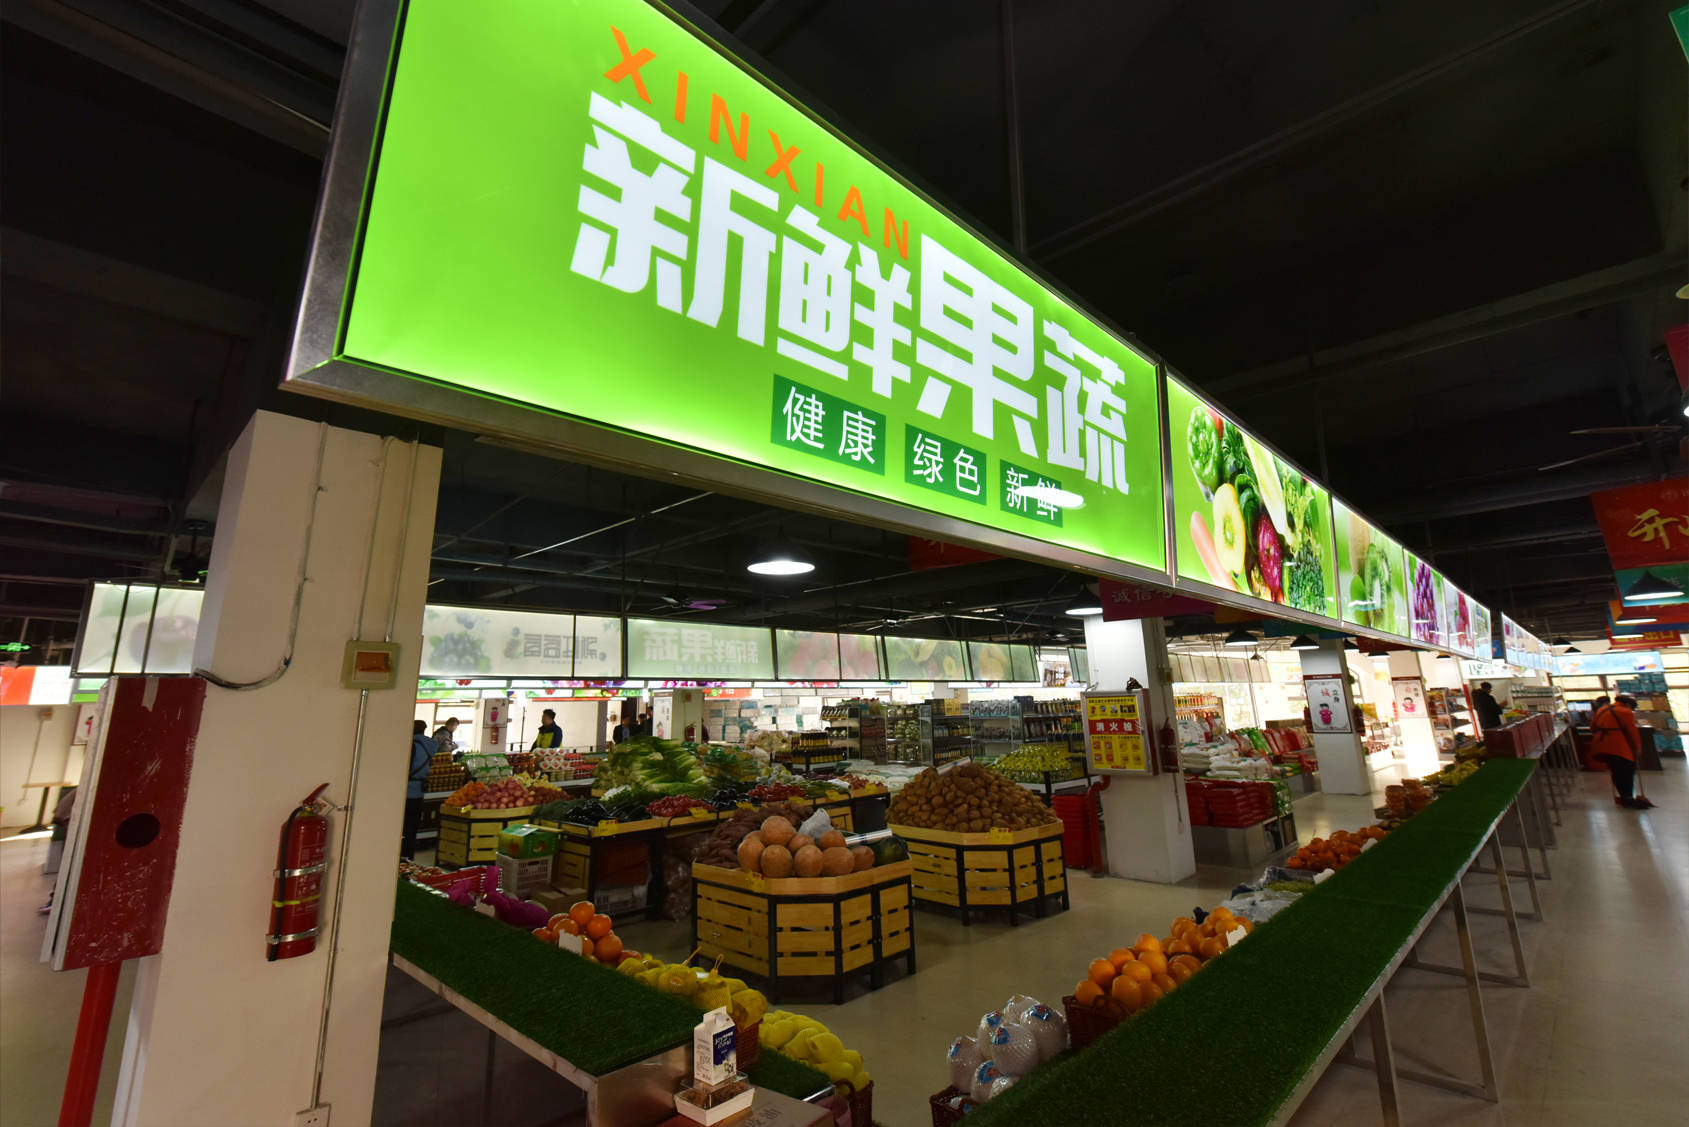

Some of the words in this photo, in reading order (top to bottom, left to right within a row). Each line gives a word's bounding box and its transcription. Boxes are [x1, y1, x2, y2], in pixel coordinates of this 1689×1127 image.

[603, 24, 909, 260] XINXIAN
[569, 90, 1129, 496] 新鲜果蔬
[781, 386, 877, 464] 健康
[912, 434, 981, 496] 绿色
[1627, 508, 1689, 550] 开
